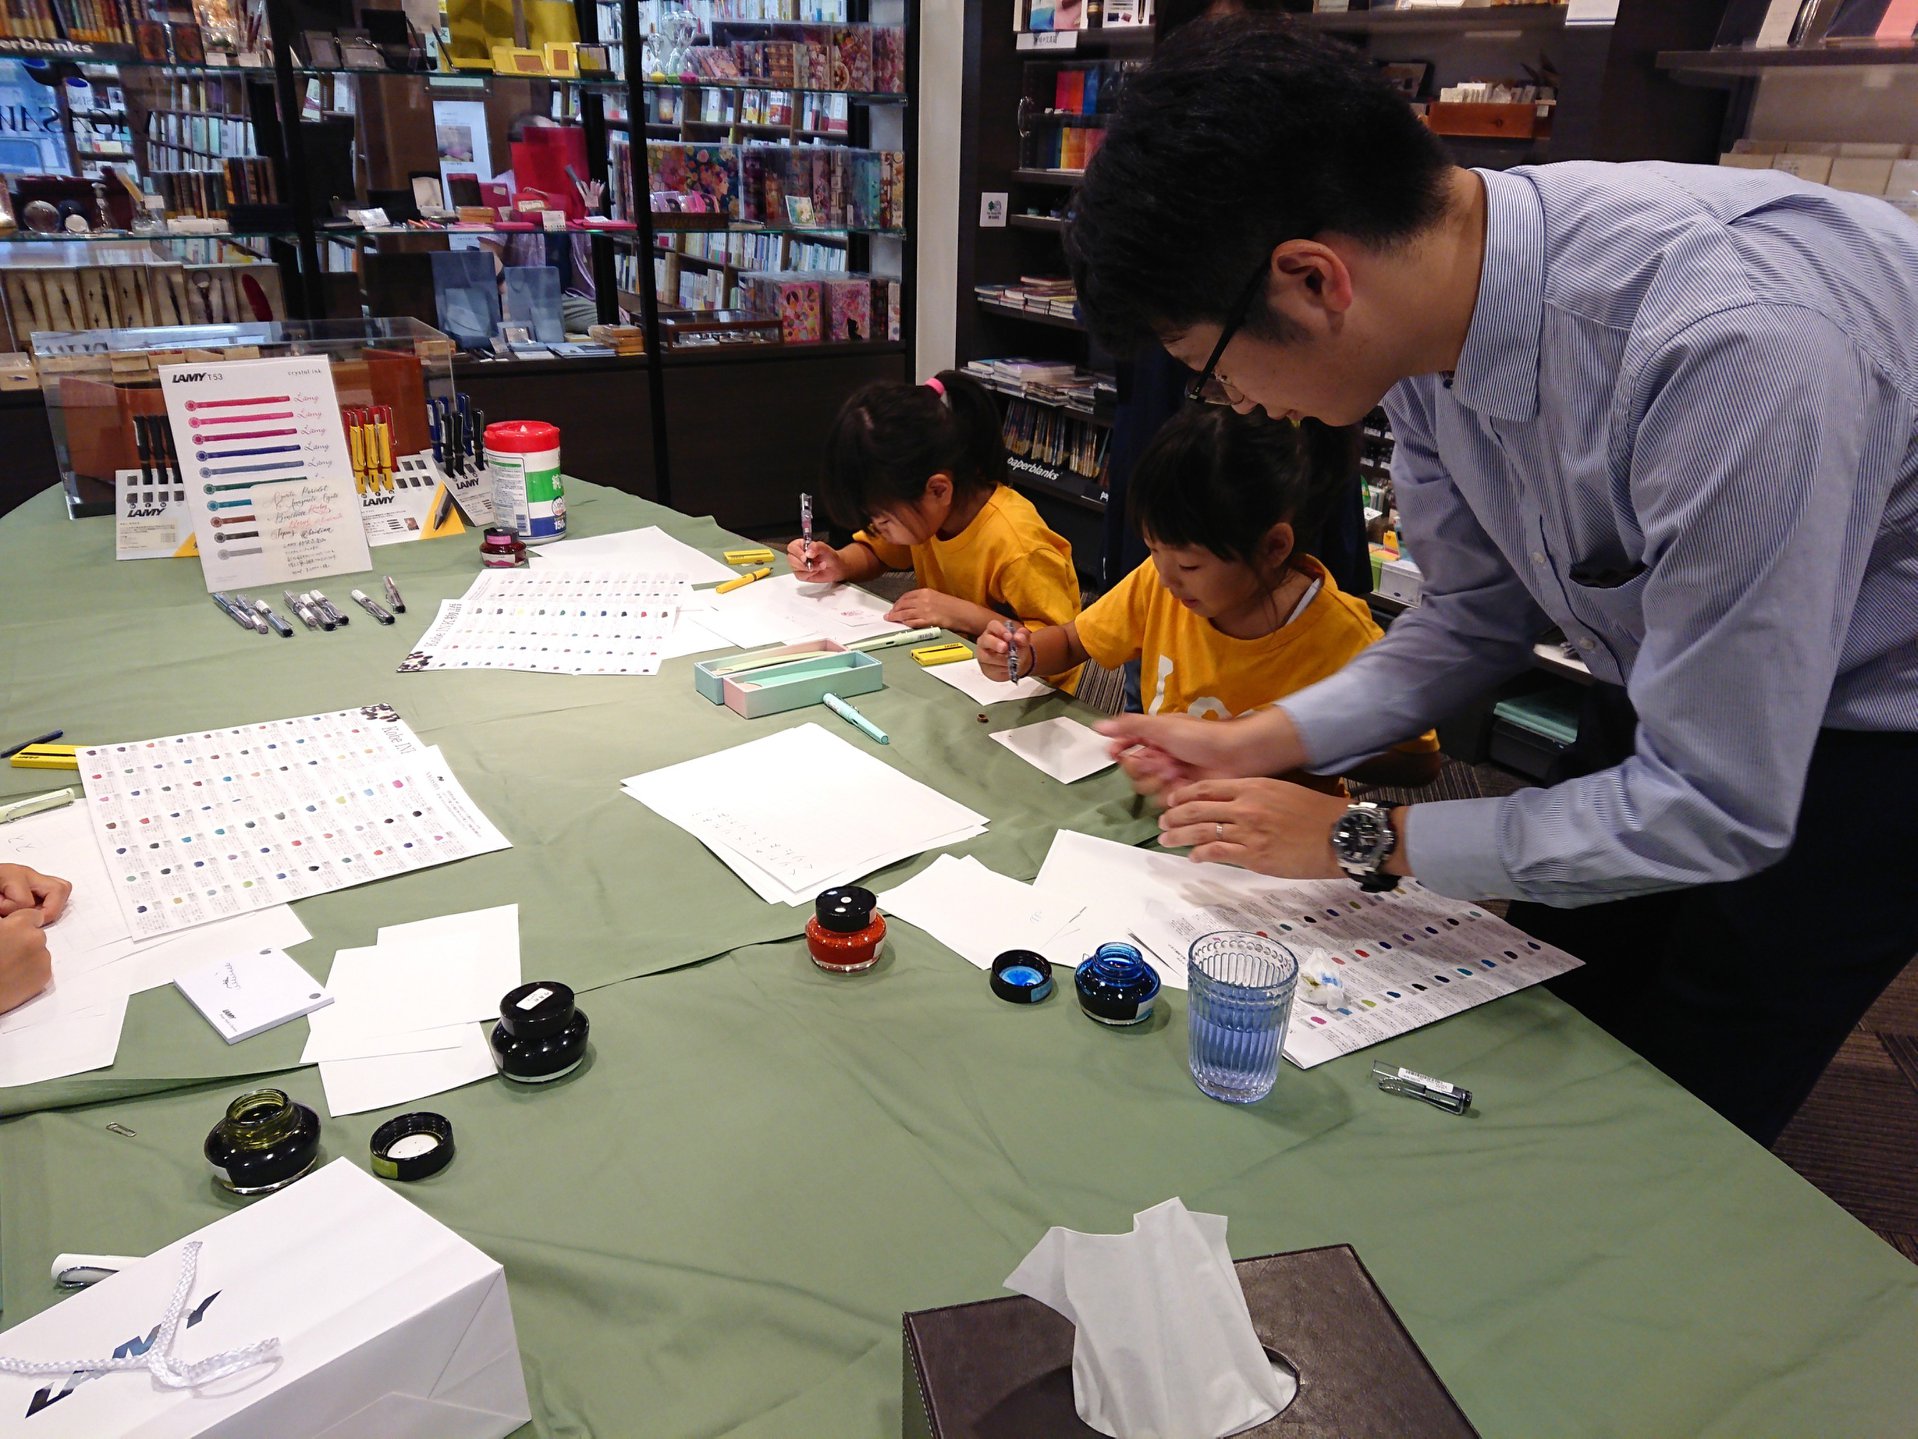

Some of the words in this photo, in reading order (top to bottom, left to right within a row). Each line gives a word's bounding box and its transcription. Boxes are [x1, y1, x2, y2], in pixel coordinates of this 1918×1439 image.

[172, 373, 207, 383] LAMY
[456, 478, 480, 491] LAMY
[363, 496, 395, 507] LAMY
[127, 508, 167, 518] LAMY
[381, 726, 403, 743] Kobe
